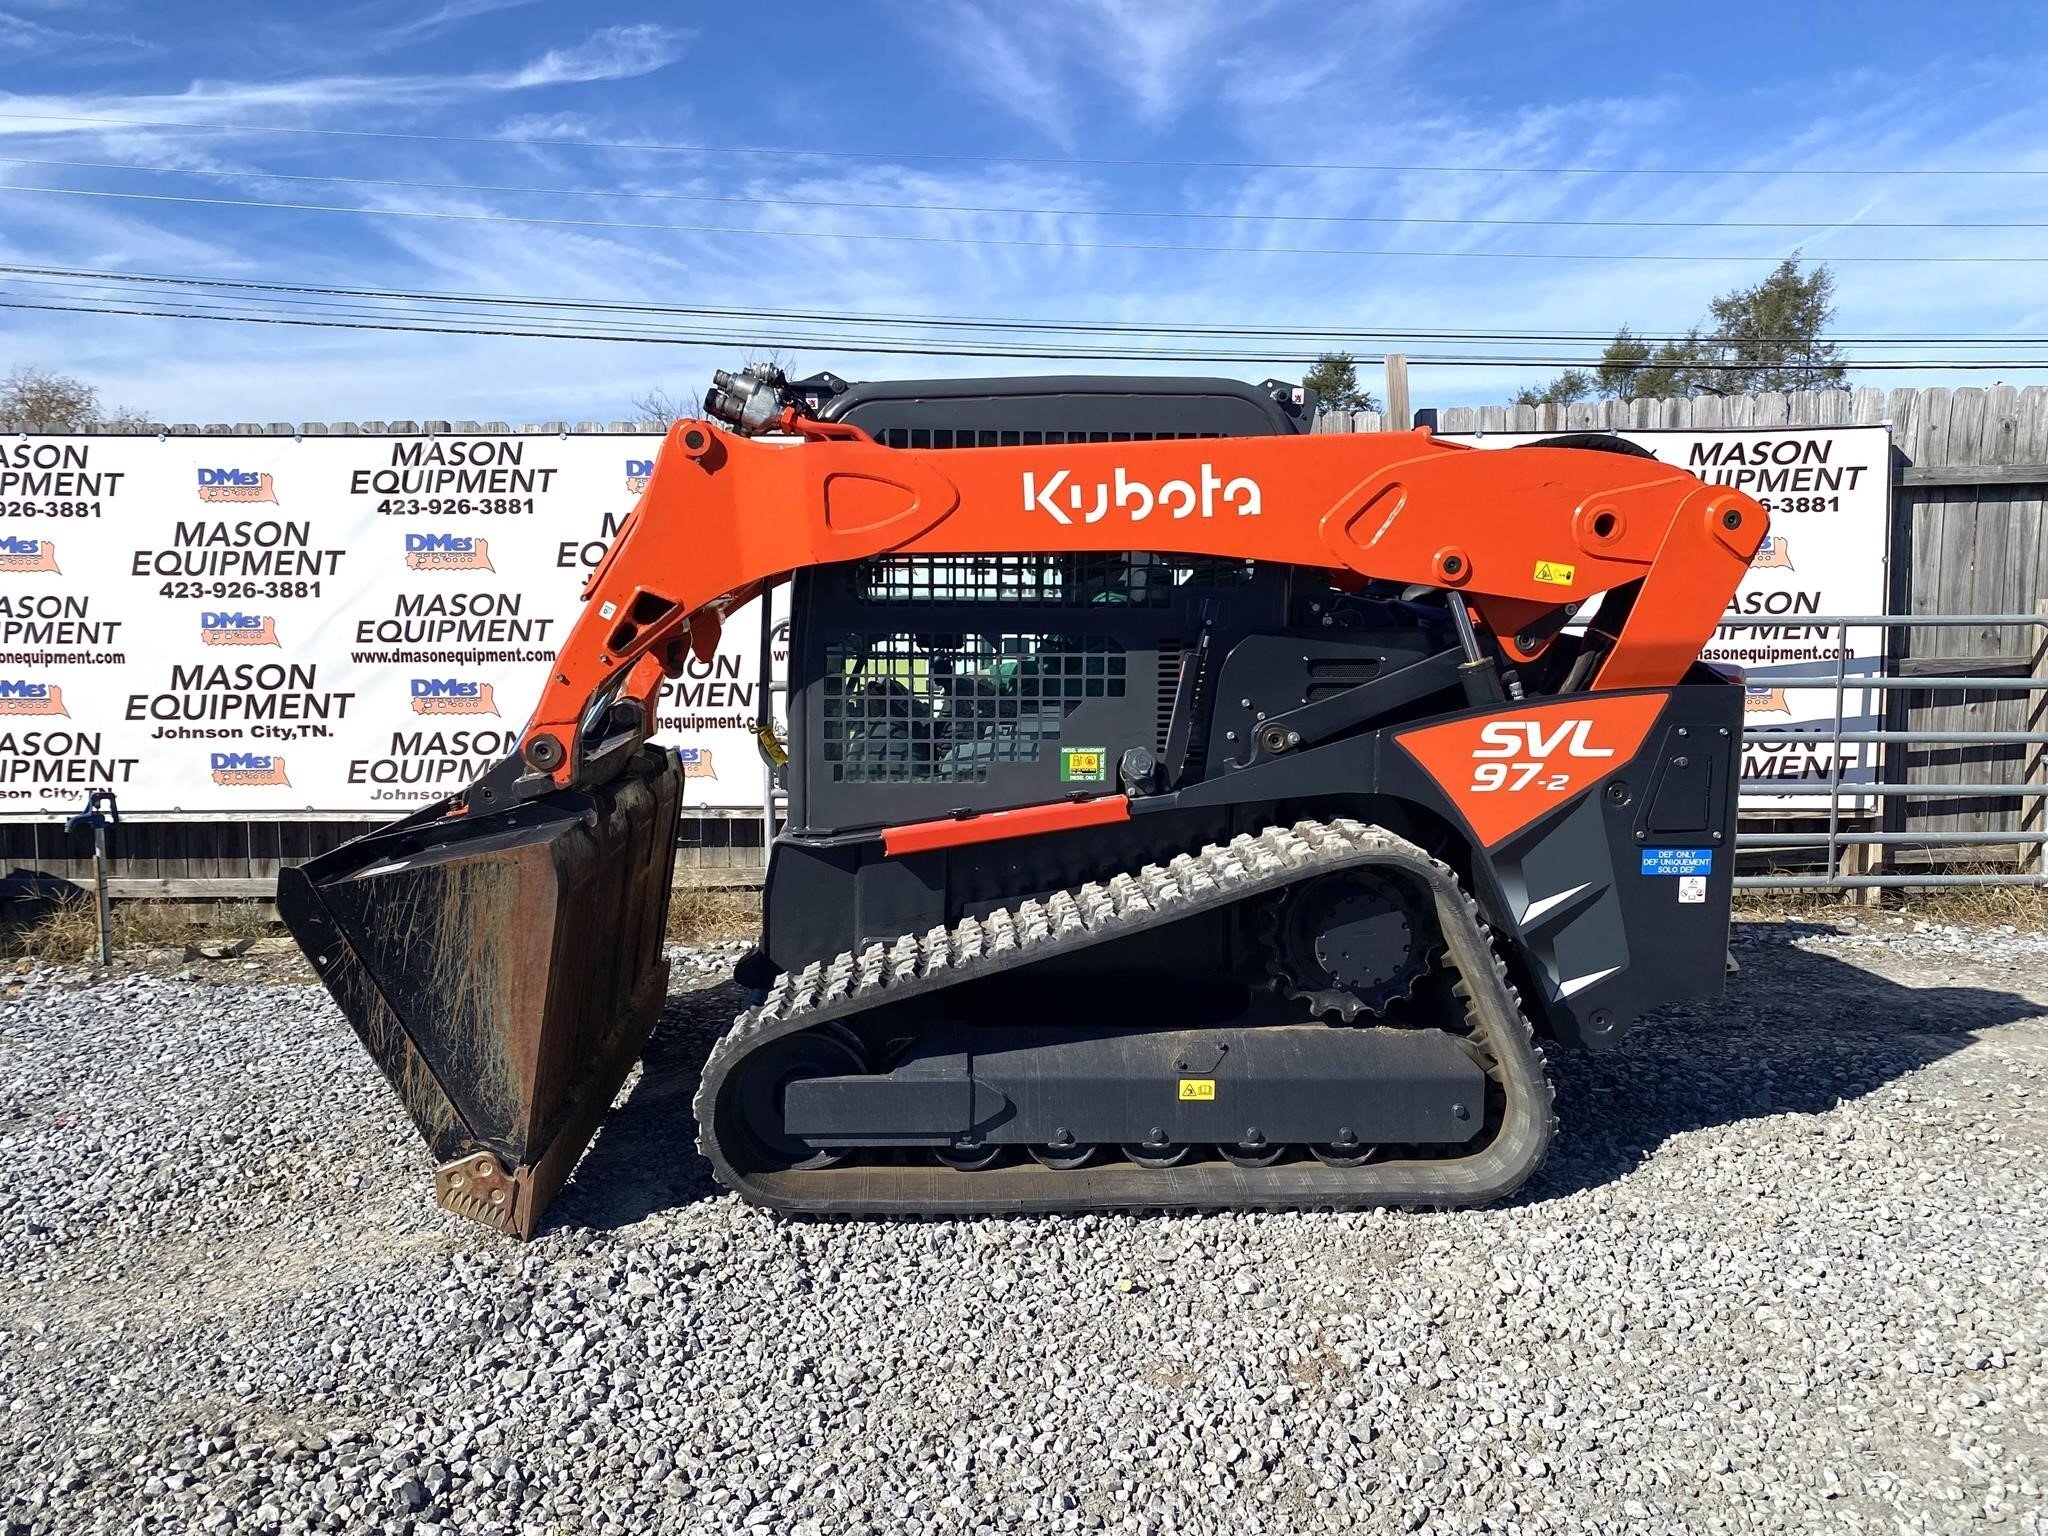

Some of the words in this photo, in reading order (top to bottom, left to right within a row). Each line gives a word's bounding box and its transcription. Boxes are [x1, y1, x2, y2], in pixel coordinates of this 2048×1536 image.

[391, 441, 523, 466] MASON
[1689, 440, 1832, 465] MASON
[351, 469, 557, 494] EQUIPMENT
[1684, 466, 1868, 491] UIPMENT
[1024, 463, 1262, 525] Kubota
[377, 499, 533, 515] 423-926-3881
[174, 521, 310, 547] MASON
[132, 551, 346, 576] EQUIPMENT
[160, 582, 320, 598] 423-926-3881
[395, 594, 521, 616] MASON
[0, 621, 121, 644] PMENT
[356, 620, 553, 643] EQUIPMENT
[351, 648, 556, 666] www.dmasonequipment.com
[171, 664, 316, 690] MASON
[125, 693, 355, 720] EQUIPMENT
[152, 727, 243, 738] Johnson
[1472, 720, 1614, 757] SVL
[347, 759, 504, 784] EQUIPM
[1471, 763, 1569, 791] 97-2
[1643, 858, 1659, 866] DEF
[1660, 858, 1711, 866] UNIQUEMENT
